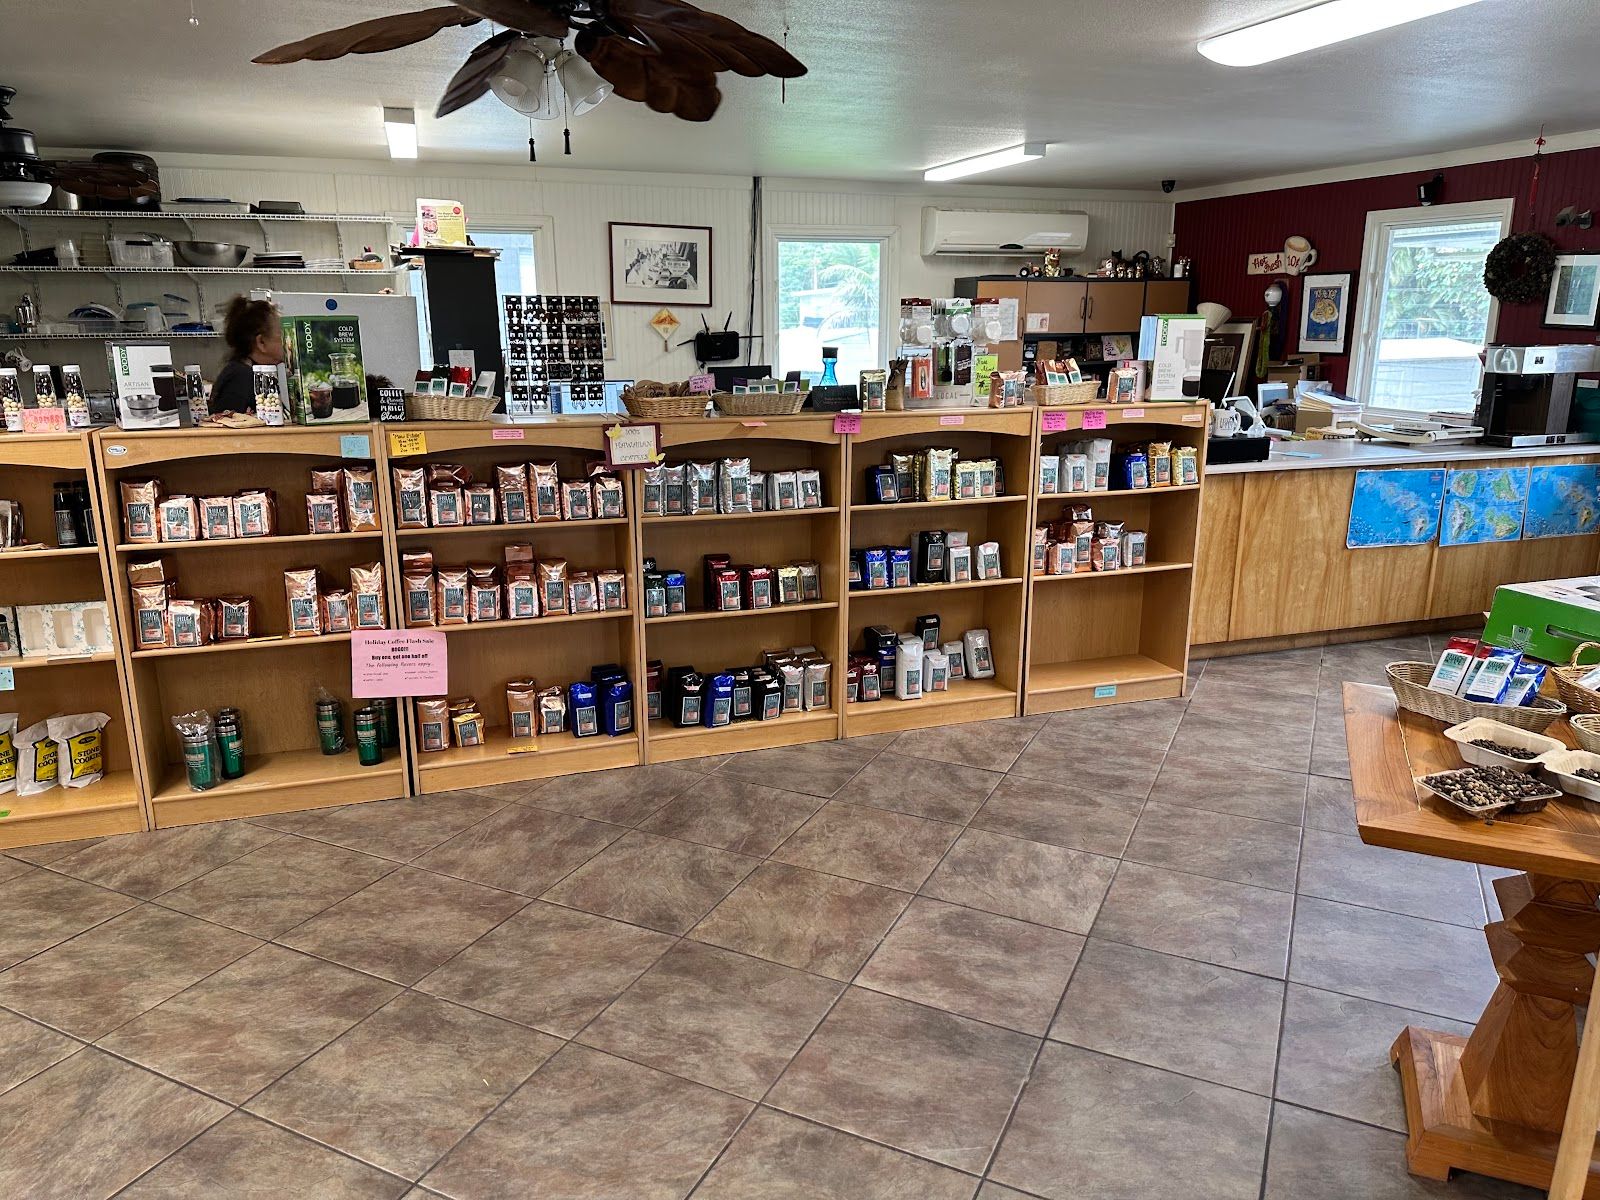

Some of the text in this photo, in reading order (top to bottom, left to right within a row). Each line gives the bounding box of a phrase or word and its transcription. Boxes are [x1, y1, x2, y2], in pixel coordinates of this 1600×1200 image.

[1252, 256, 1268, 269] Hot
[304, 321, 314, 354] TODDY
[121, 348, 129, 376] TODDY
[936, 391, 958, 400] LOCAL
[78, 746, 100, 757] STONE
